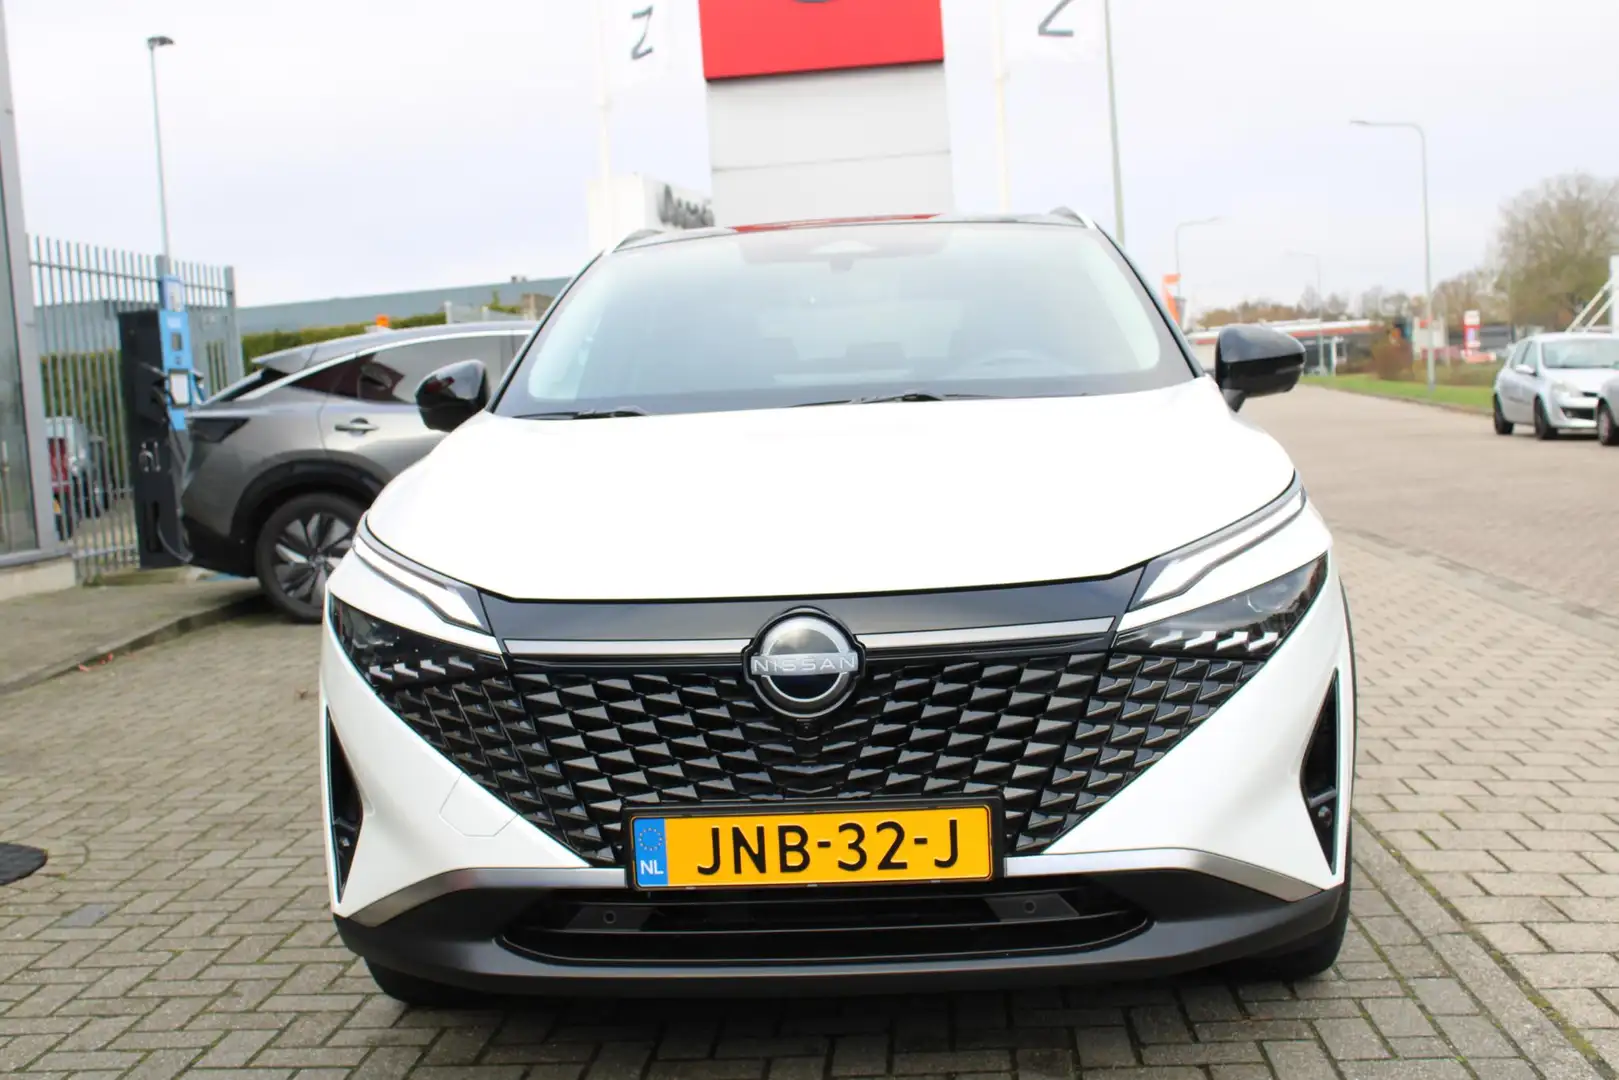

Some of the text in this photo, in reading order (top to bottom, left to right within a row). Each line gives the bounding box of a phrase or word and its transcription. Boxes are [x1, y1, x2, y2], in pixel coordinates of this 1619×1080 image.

[753, 656, 856, 673] NISSAN
[697, 819, 959, 876] JNB-32-J
[640, 859, 664, 875] NL
